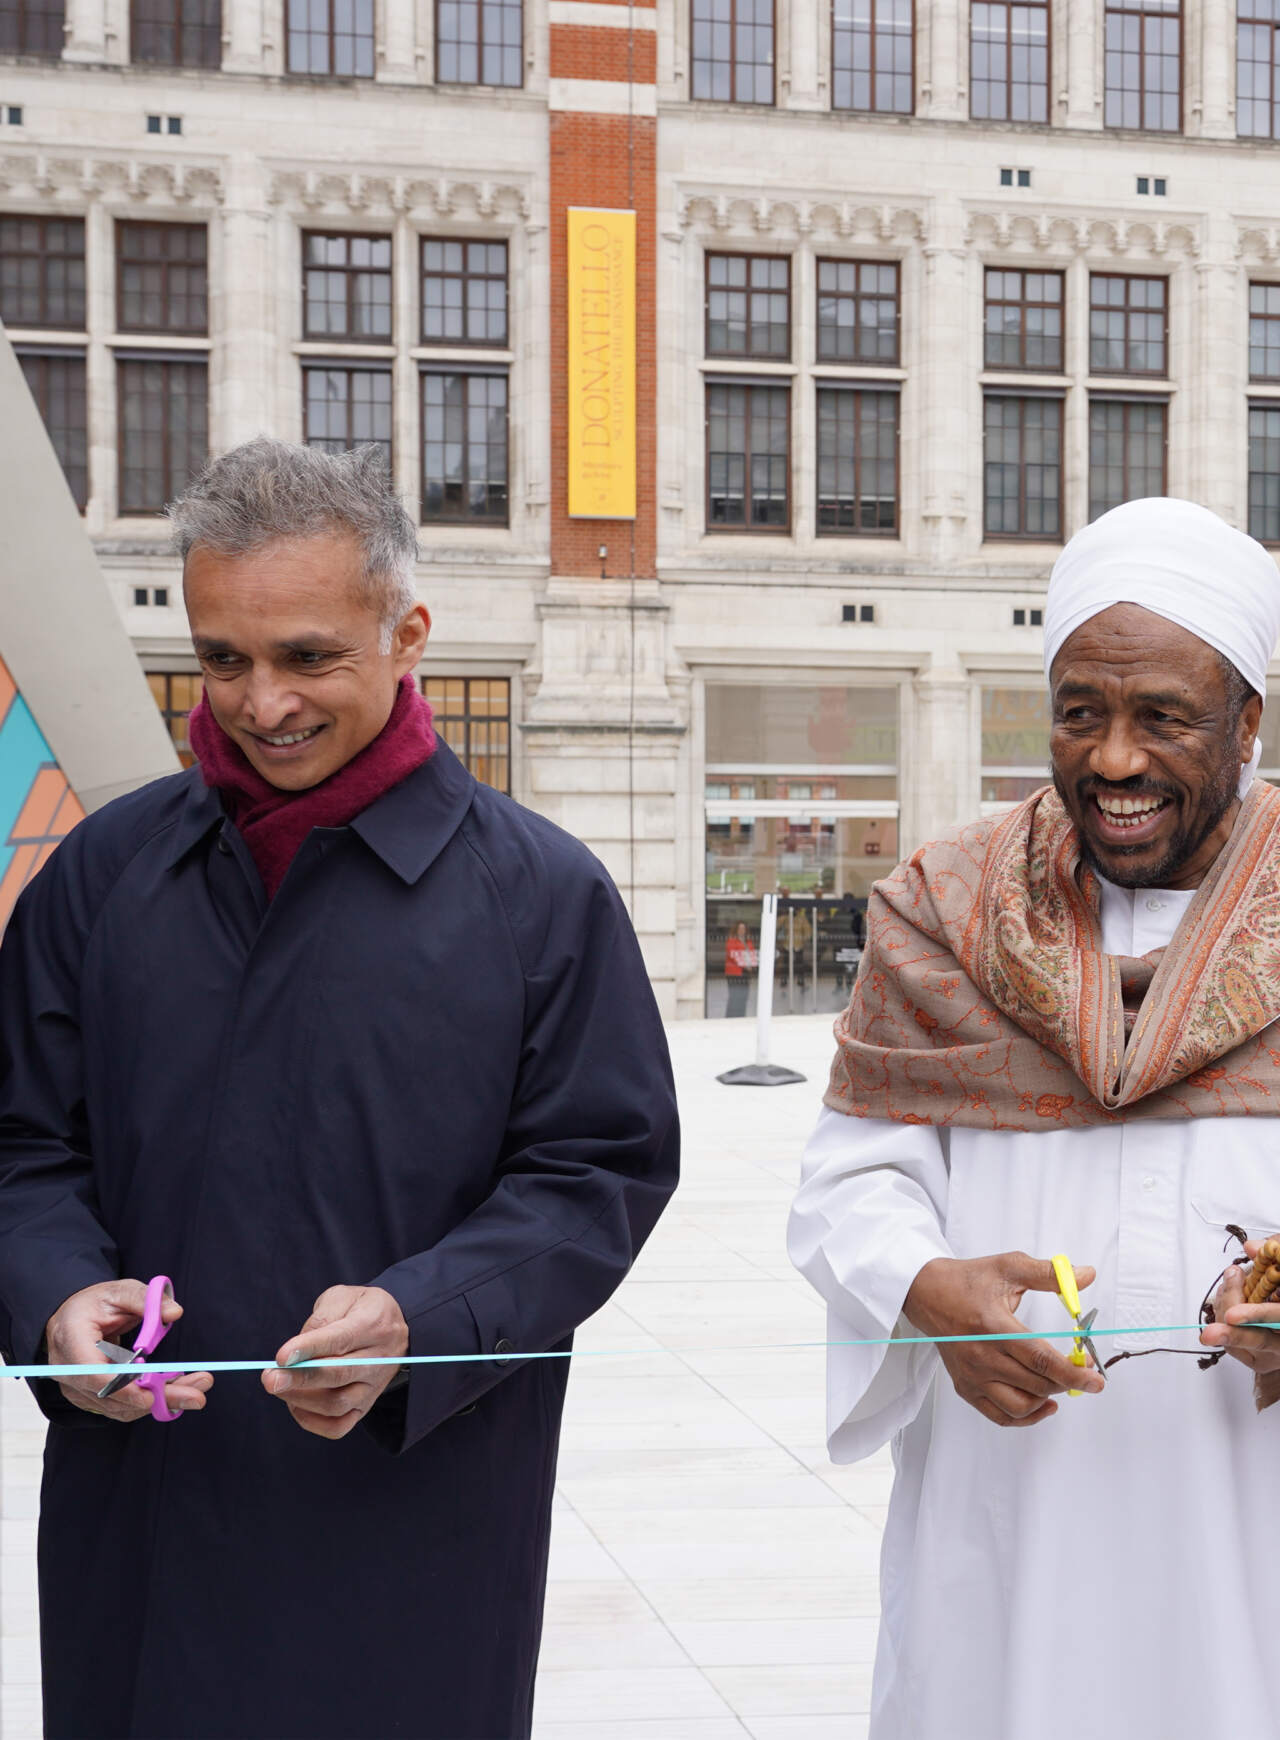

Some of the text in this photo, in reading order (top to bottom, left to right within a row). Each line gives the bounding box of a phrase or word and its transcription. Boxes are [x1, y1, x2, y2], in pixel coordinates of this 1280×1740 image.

[581, 223, 611, 448] DONATELLO
[613, 235, 625, 441] SCULPTING THE RENAISSANCE
